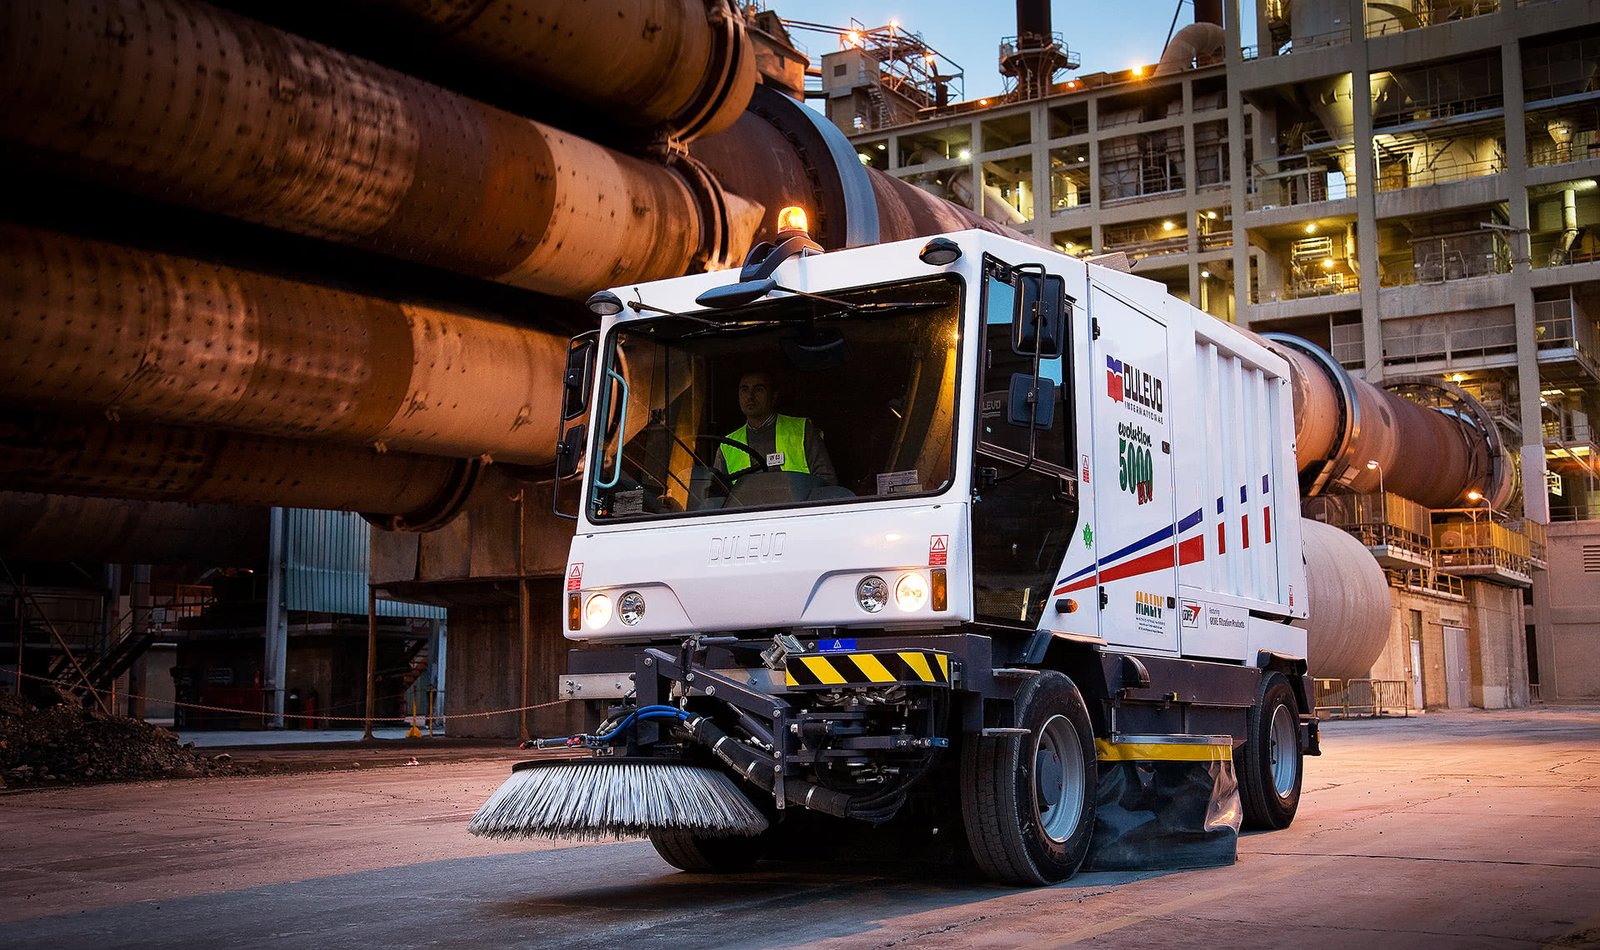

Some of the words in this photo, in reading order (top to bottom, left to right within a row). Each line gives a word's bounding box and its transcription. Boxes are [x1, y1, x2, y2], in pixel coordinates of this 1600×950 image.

[1123, 362, 1163, 413] DULEVO
[1124, 401, 1164, 425] INTERNATIONAL
[1118, 421, 1152, 447] evolution
[1119, 437, 1153, 500] 5000
[707, 532, 787, 567] DULEVO
